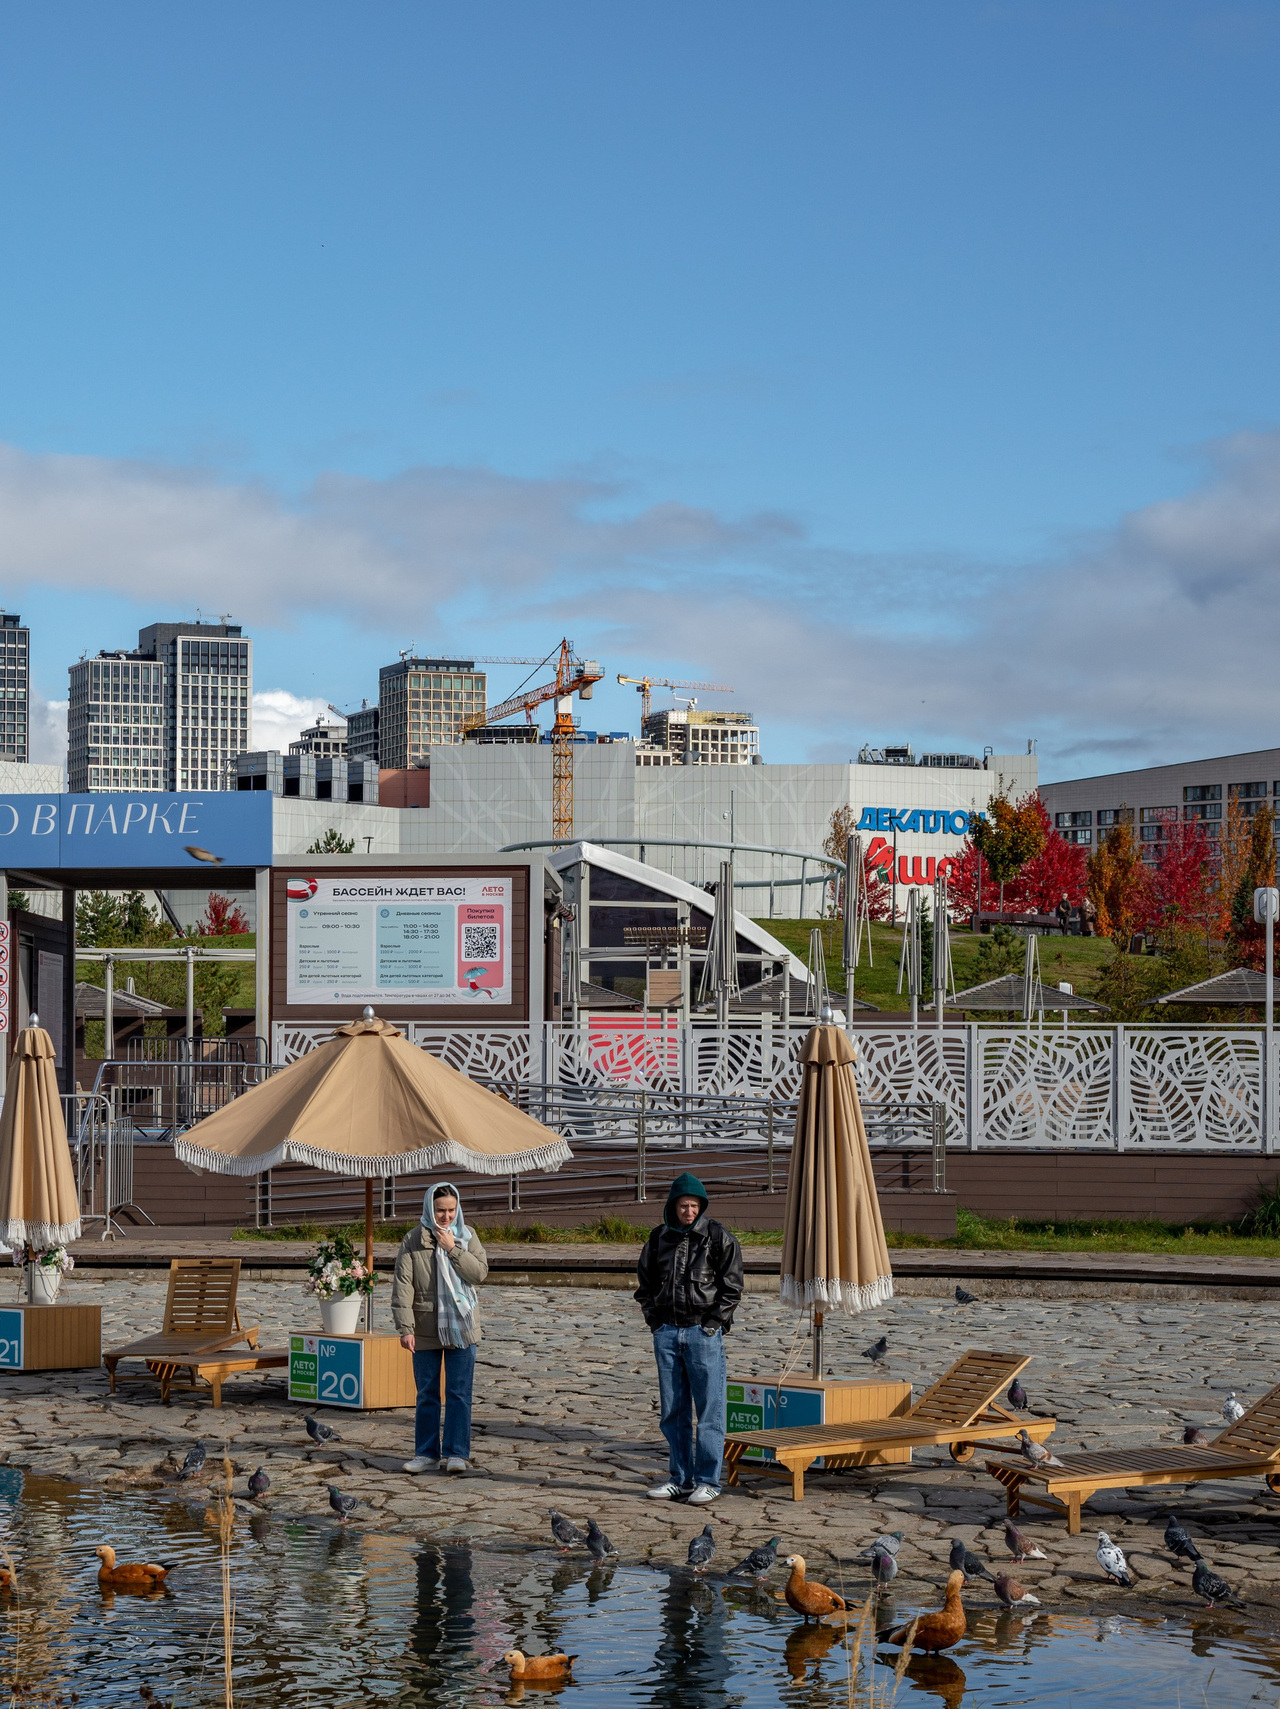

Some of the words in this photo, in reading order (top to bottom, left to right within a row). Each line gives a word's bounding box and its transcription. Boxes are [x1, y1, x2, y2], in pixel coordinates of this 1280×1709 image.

[31, 803, 57, 836] В
[66, 801, 204, 835] ПАРКЕ
[332, 886, 393, 896] БАССЕЙН
[395, 887, 435, 897] ЖДЕТ
[436, 887, 466, 896] ВАС!
[293, 1360, 315, 1369] ЛЕТО
[321, 1371, 359, 1400] 20
[730, 1412, 760, 1424] ЛЕТО
